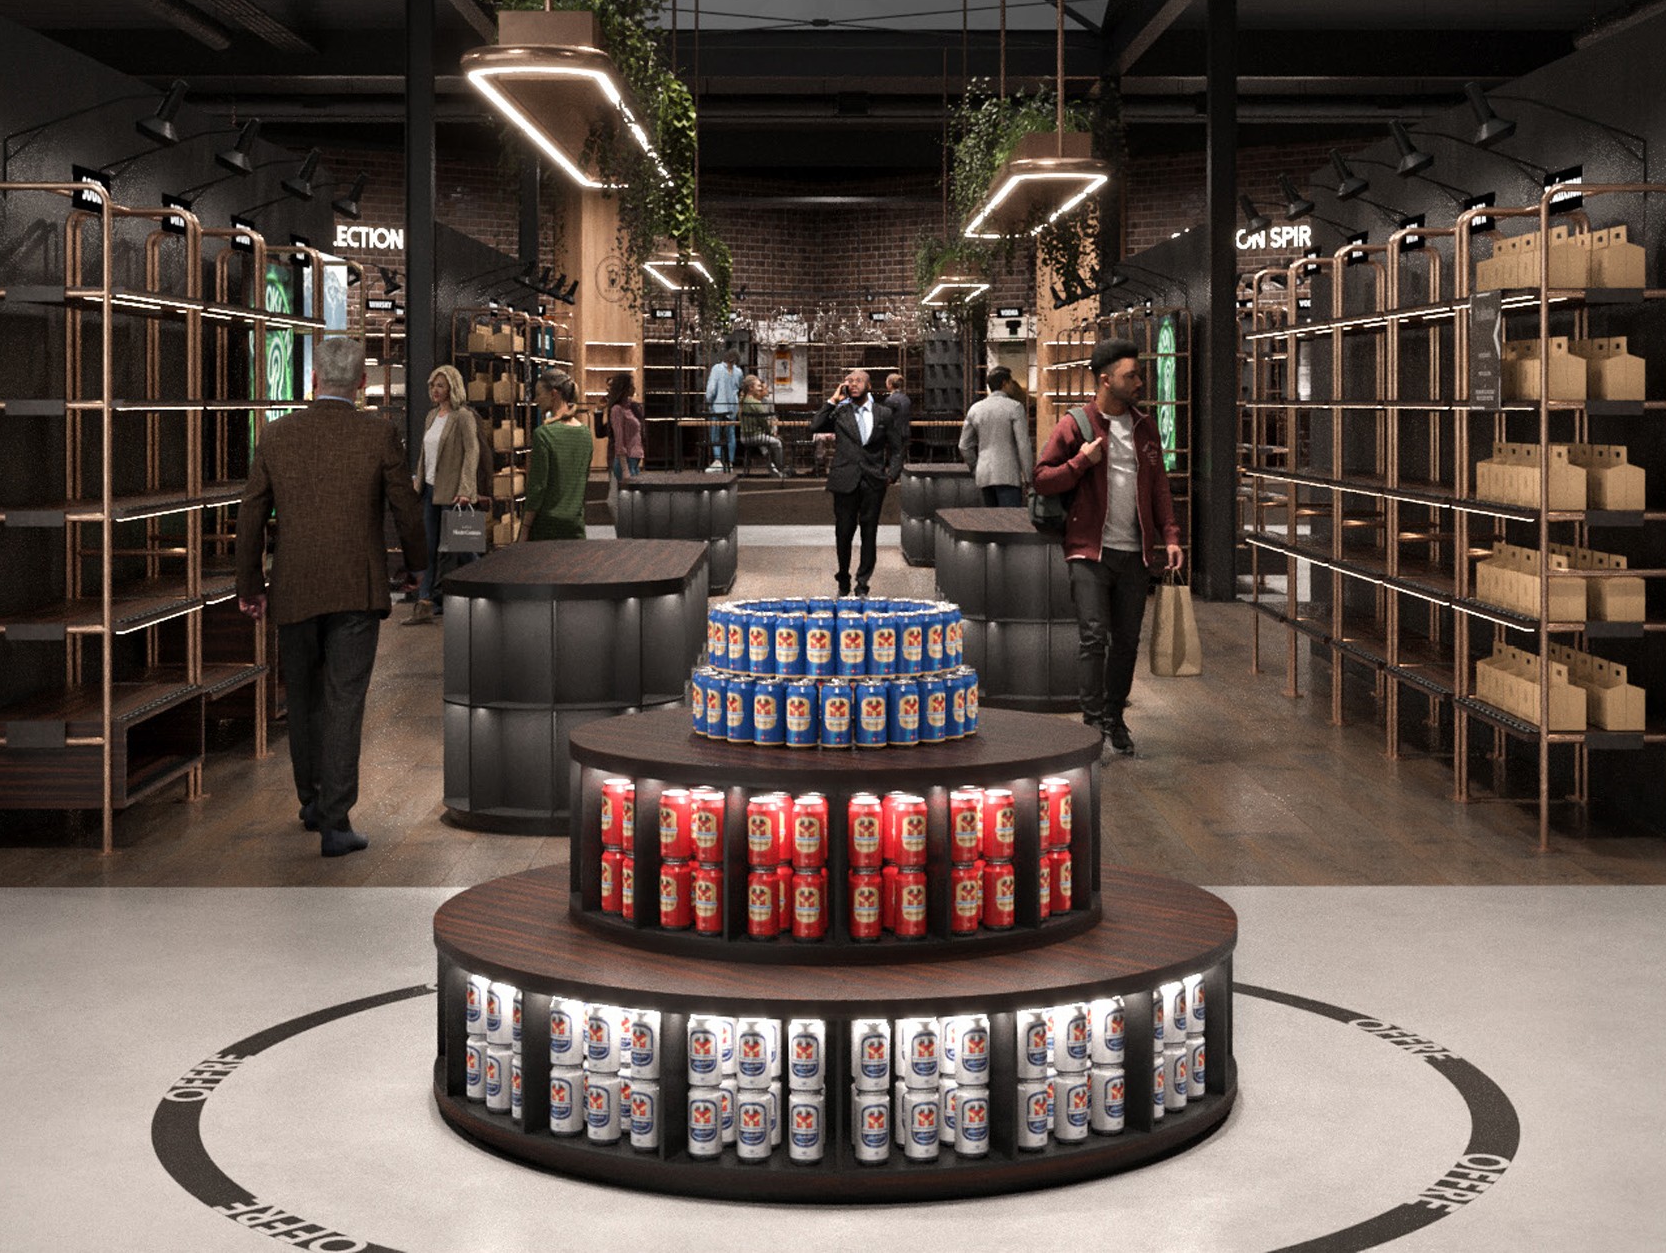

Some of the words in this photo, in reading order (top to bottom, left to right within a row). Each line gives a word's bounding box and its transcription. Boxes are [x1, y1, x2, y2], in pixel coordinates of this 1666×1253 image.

[333, 225, 404, 249] ECTION
[1270, 225, 1312, 248] SPIR
[1348, 1018, 1463, 1061] OFFRE
[164, 1052, 254, 1102] OFFRE
[1417, 1153, 1511, 1214] OFFRE
[213, 1196, 368, 1253] OFFRE
